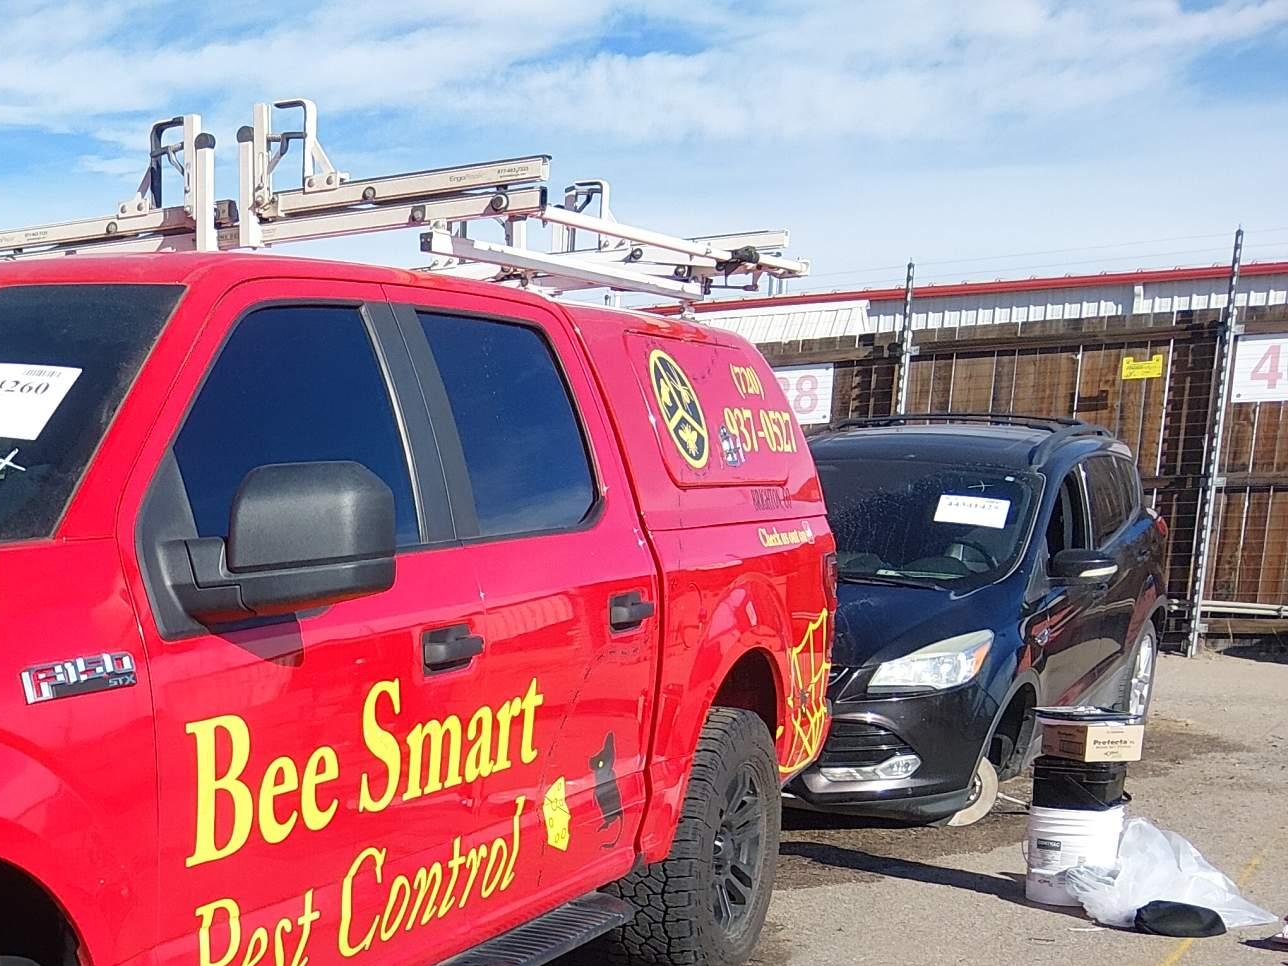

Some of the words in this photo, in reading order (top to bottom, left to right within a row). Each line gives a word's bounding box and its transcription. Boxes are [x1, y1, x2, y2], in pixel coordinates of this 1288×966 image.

[729, 362, 765, 400] (720)
[723, 406, 798, 453] 937-0527
[757, 526, 783, 548] Check
[108, 674, 137, 688] STX
[184, 713, 341, 868] Bee
[358, 677, 544, 814] Smart
[337, 794, 526, 959] Control
